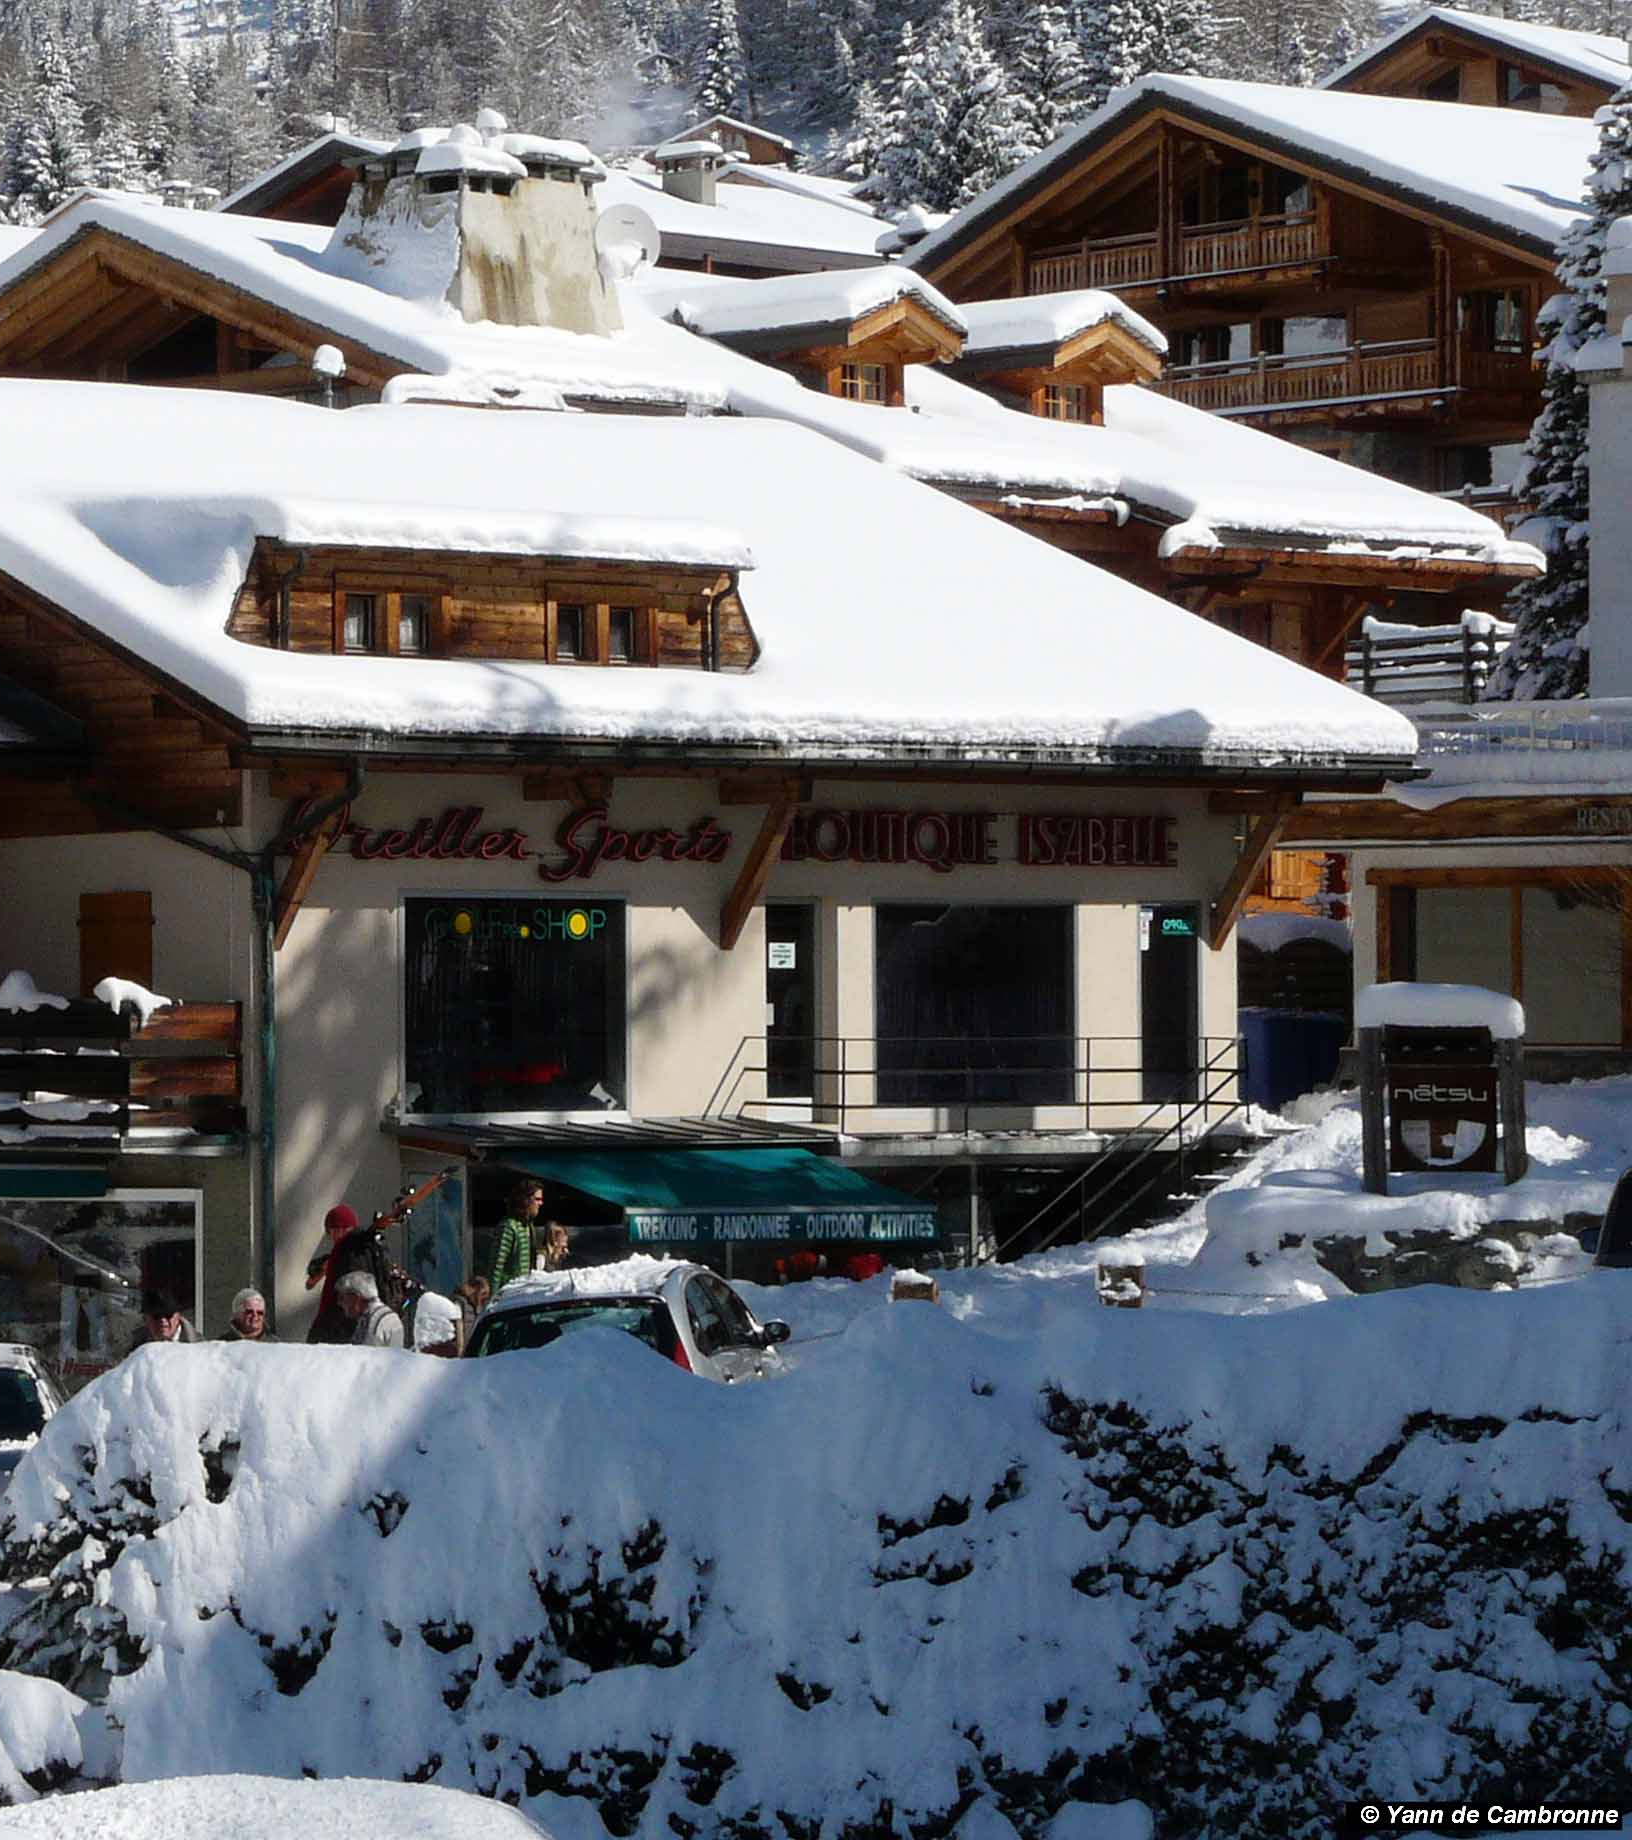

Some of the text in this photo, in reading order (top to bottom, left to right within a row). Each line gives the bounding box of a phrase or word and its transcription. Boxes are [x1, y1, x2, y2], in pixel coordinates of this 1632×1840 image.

[539, 806, 734, 882] Sports
[782, 811, 1179, 873] BOUTIQUE ISABELLE
[532, 907, 608, 941] SHOP
[634, 1215, 699, 1241] TREKKING
[713, 1214, 791, 1240] RANDONNEE
[805, 1214, 865, 1240] OUTDOOR
[869, 1212, 935, 1239] ACTIVITIES
